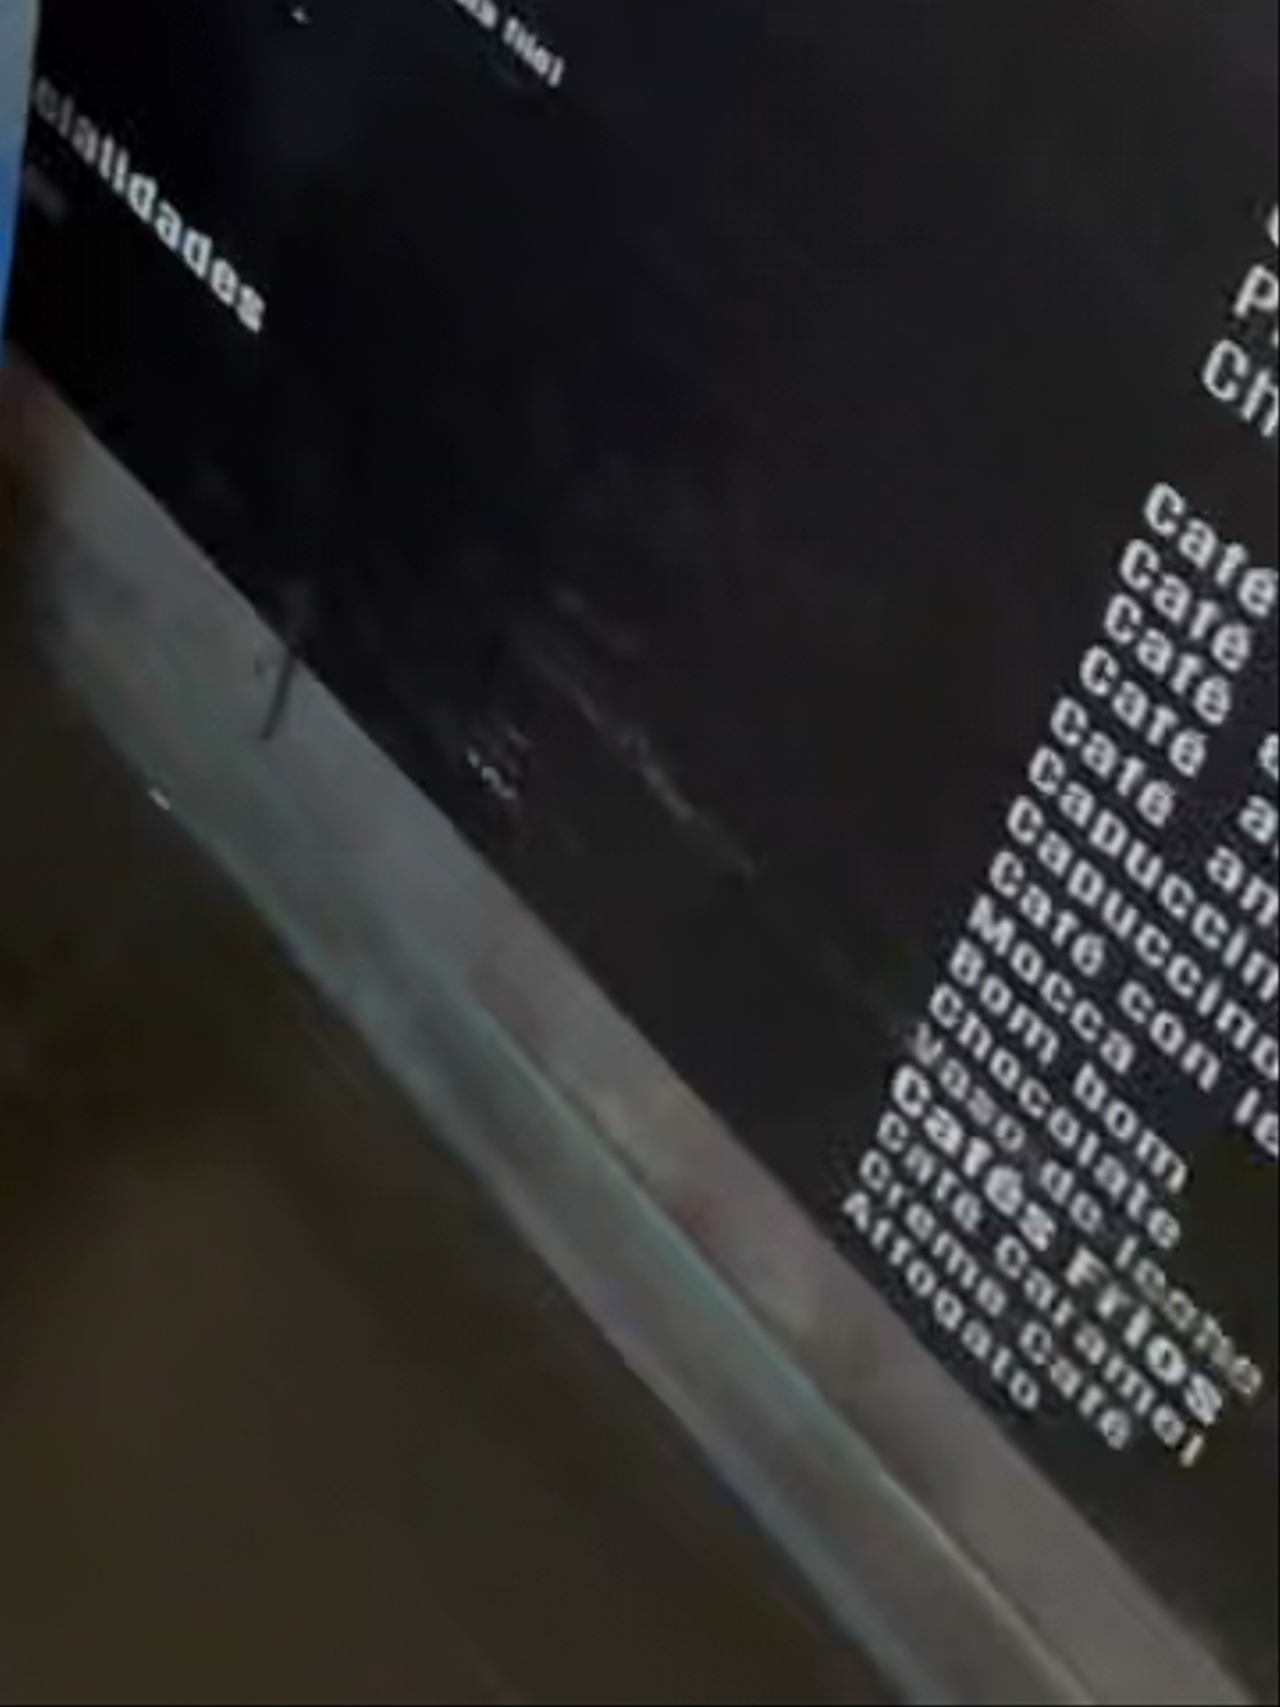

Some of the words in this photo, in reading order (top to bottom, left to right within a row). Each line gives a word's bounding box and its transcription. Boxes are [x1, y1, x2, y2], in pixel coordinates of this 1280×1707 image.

[32, 76, 268, 334] cialidades
[1234, 262, 1279, 319] P
[1202, 338, 1279, 438] Ch
[1028, 744, 1279, 1003] Capuccin
[1206, 843, 1279, 928] an
[948, 938, 1060, 1066] Bom
[1072, 1060, 1188, 1195] bom
[967, 894, 1137, 1076] Mocca
[1117, 980, 1221, 1093] con
[1234, 1086, 1279, 1158] le
[928, 981, 1182, 1251] Chocolate
